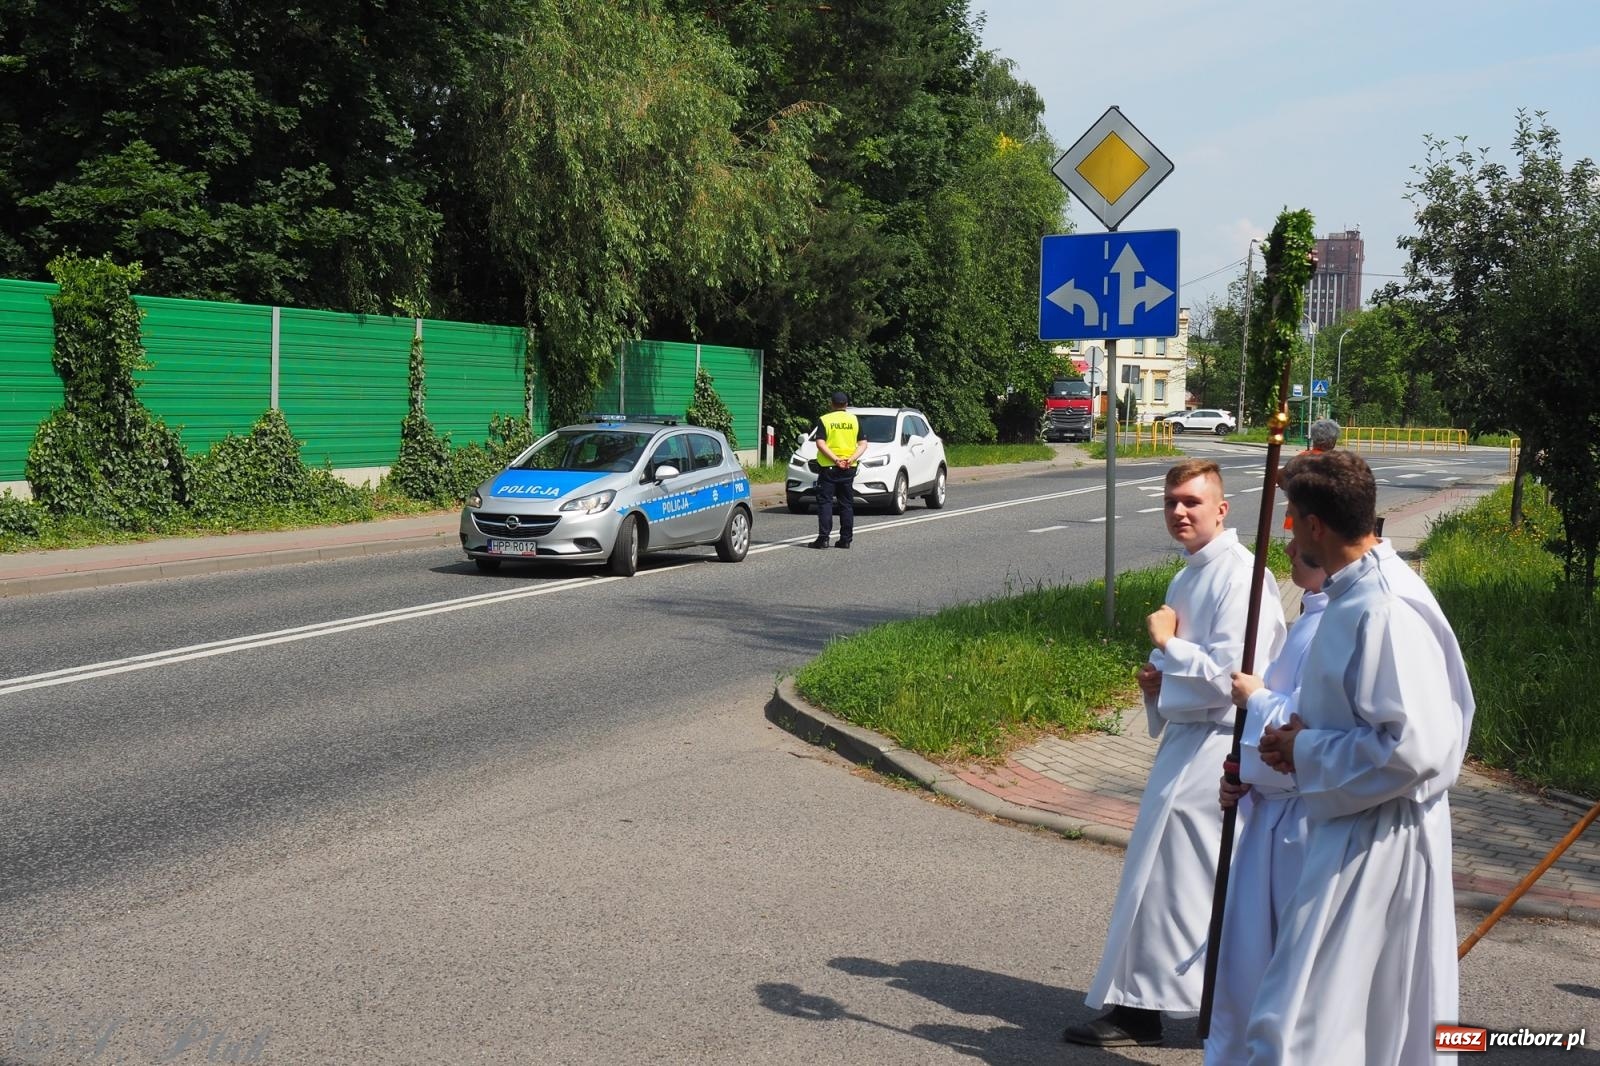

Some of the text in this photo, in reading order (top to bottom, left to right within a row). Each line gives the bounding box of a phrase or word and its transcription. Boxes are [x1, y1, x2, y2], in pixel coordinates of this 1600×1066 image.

[830, 422, 854, 430] POLICJA
[497, 485, 560, 497] POLICJA
[662, 497, 689, 515] POLICJA
[492, 541, 535, 552] HPP R012
